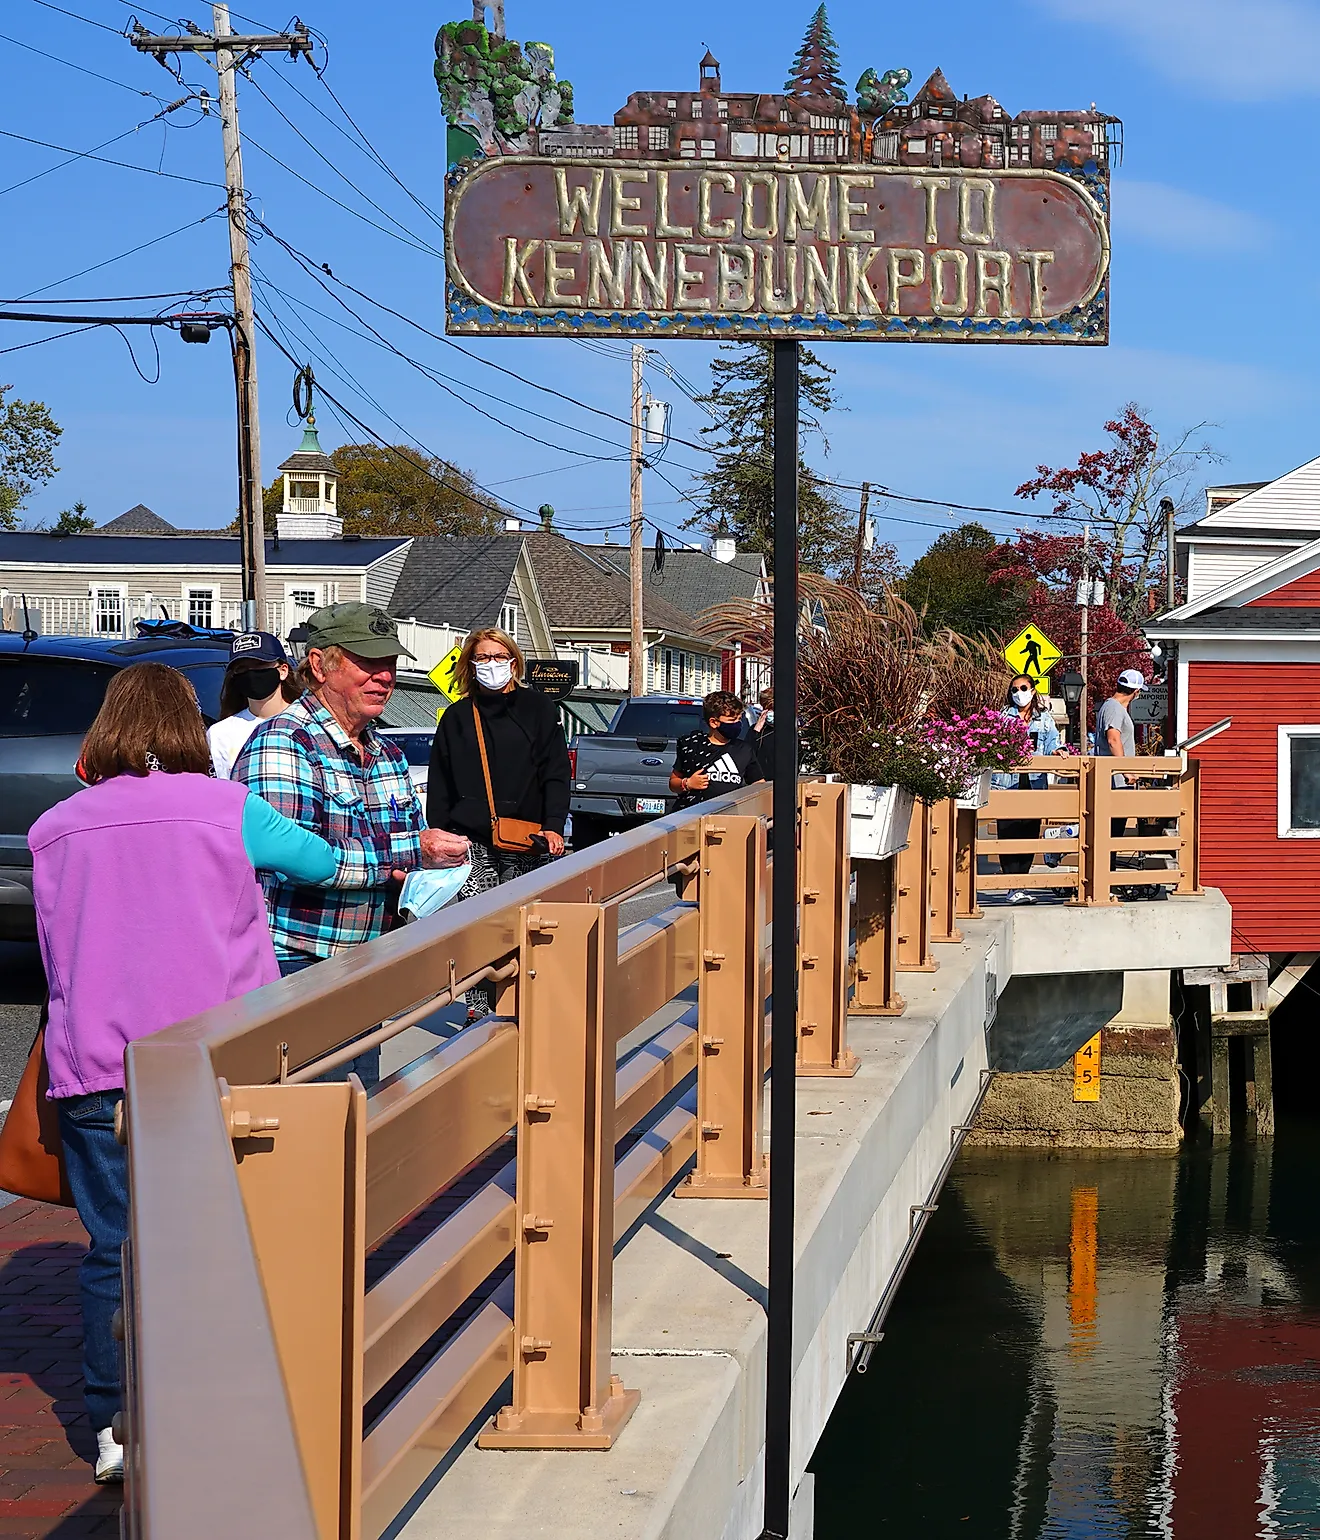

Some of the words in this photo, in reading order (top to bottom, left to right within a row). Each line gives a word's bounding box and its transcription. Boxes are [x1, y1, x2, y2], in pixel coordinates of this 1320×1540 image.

[554, 167, 874, 243] WELCOME
[912, 176, 995, 245] TO
[503, 237, 1055, 318] KENNEBUNKPORT
[1083, 1045, 1093, 1059] 4
[1083, 1070, 1092, 1084] 5
